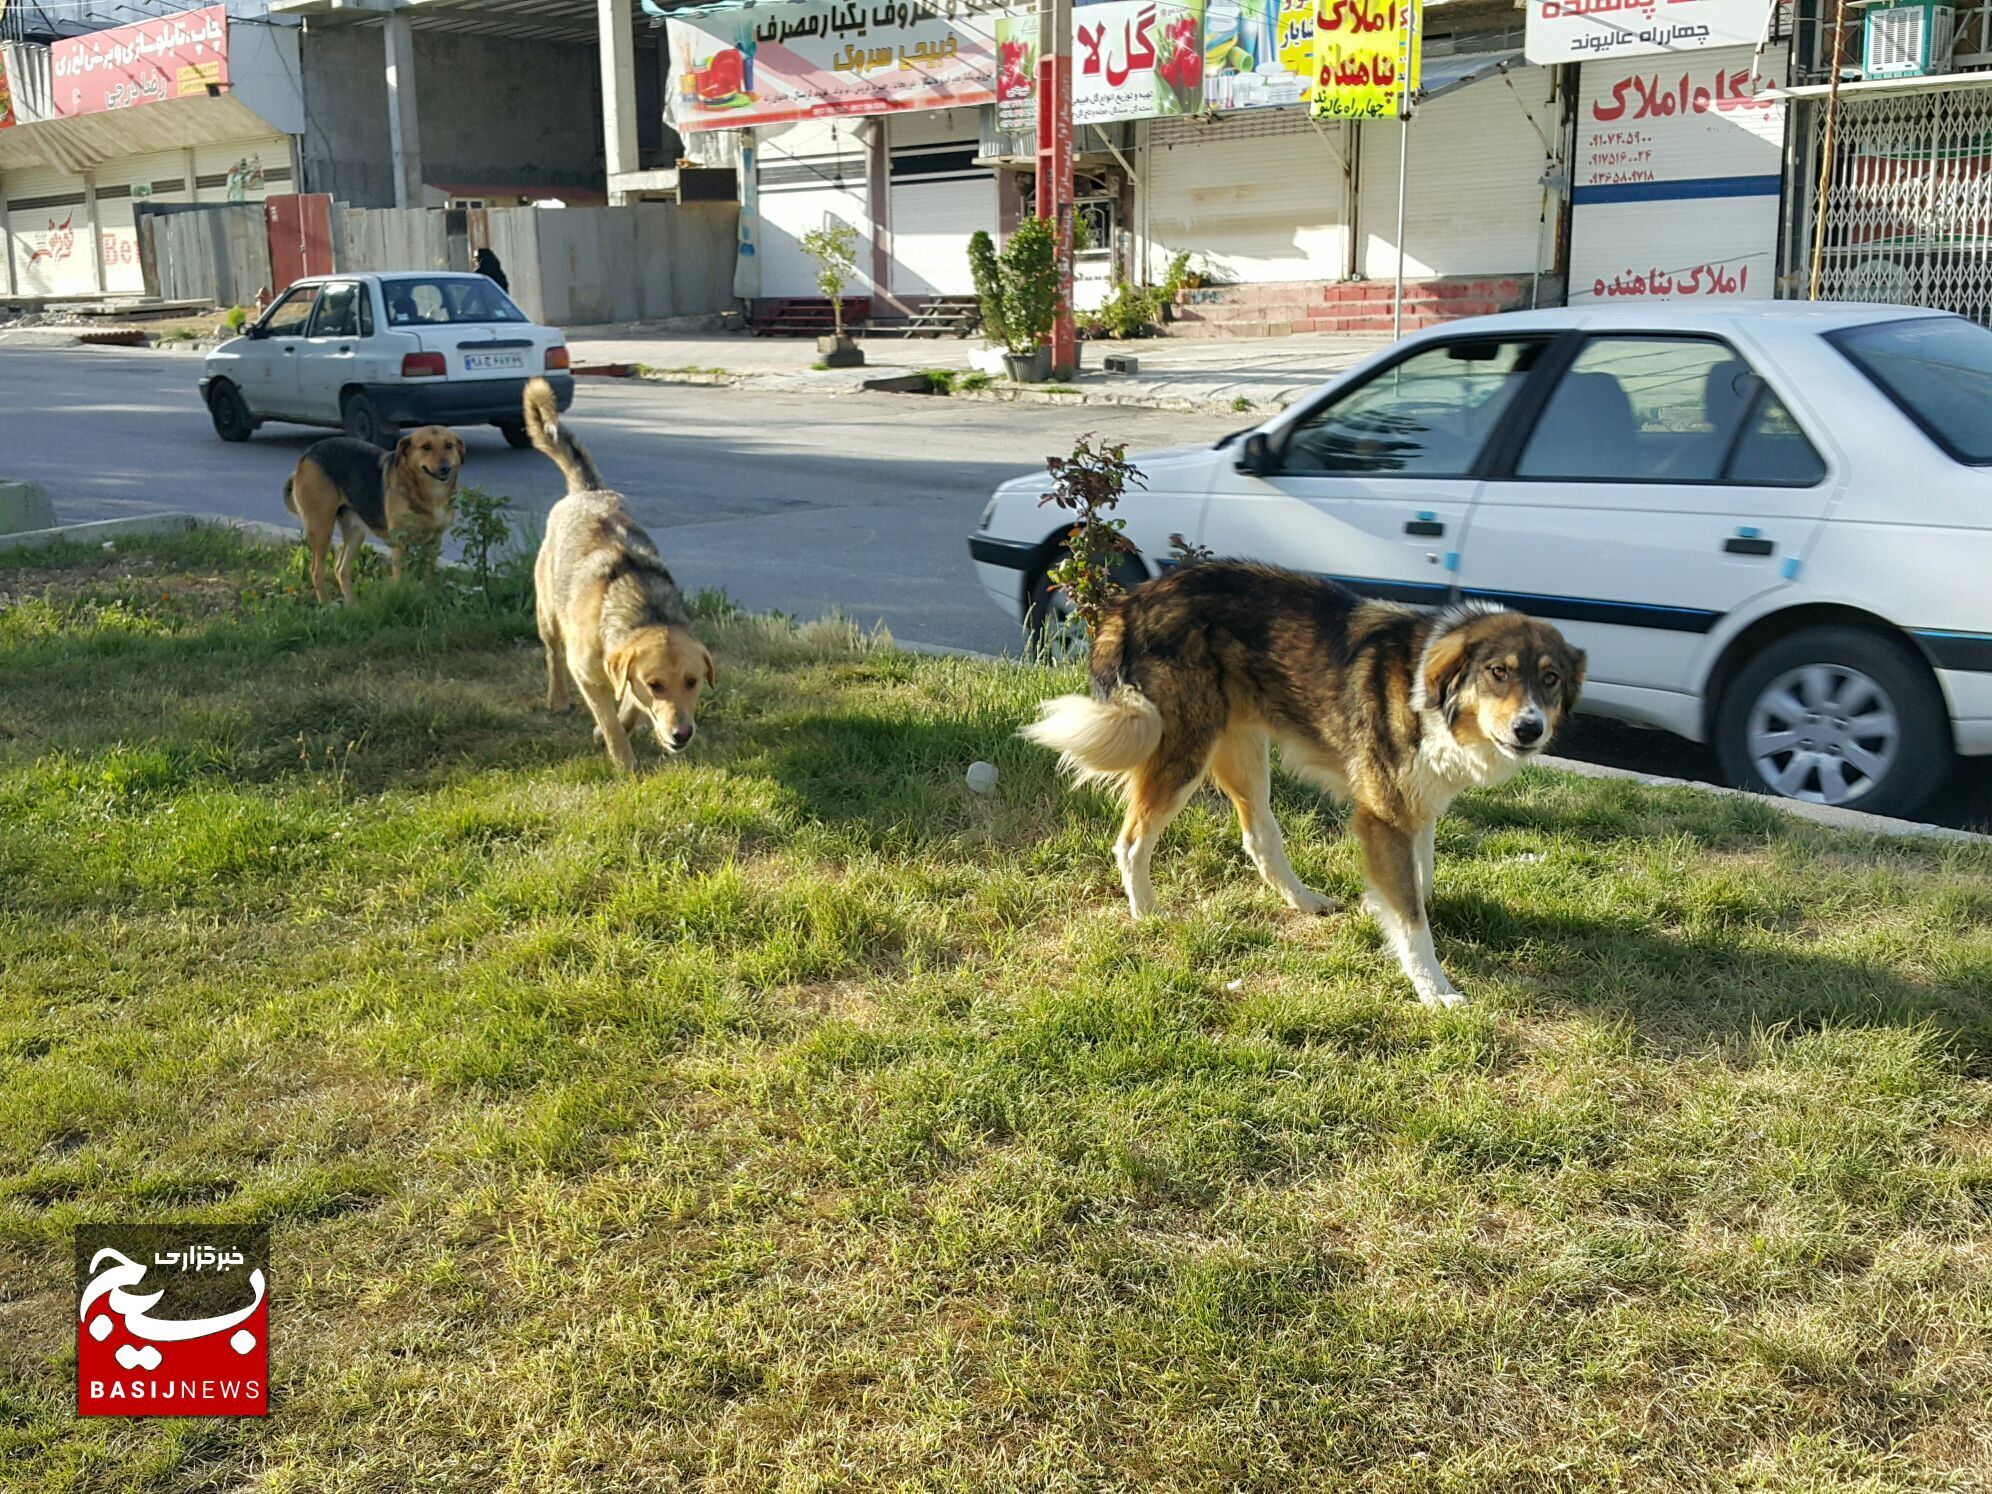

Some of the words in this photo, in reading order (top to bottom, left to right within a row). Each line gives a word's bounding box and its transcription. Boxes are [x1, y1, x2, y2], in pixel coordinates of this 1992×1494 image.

[1106, 3, 1157, 87] گل
[1570, 31, 1633, 52] عالیوند
[1592, 71, 1690, 121] املاک
[1676, 264, 1748, 296] املاک
